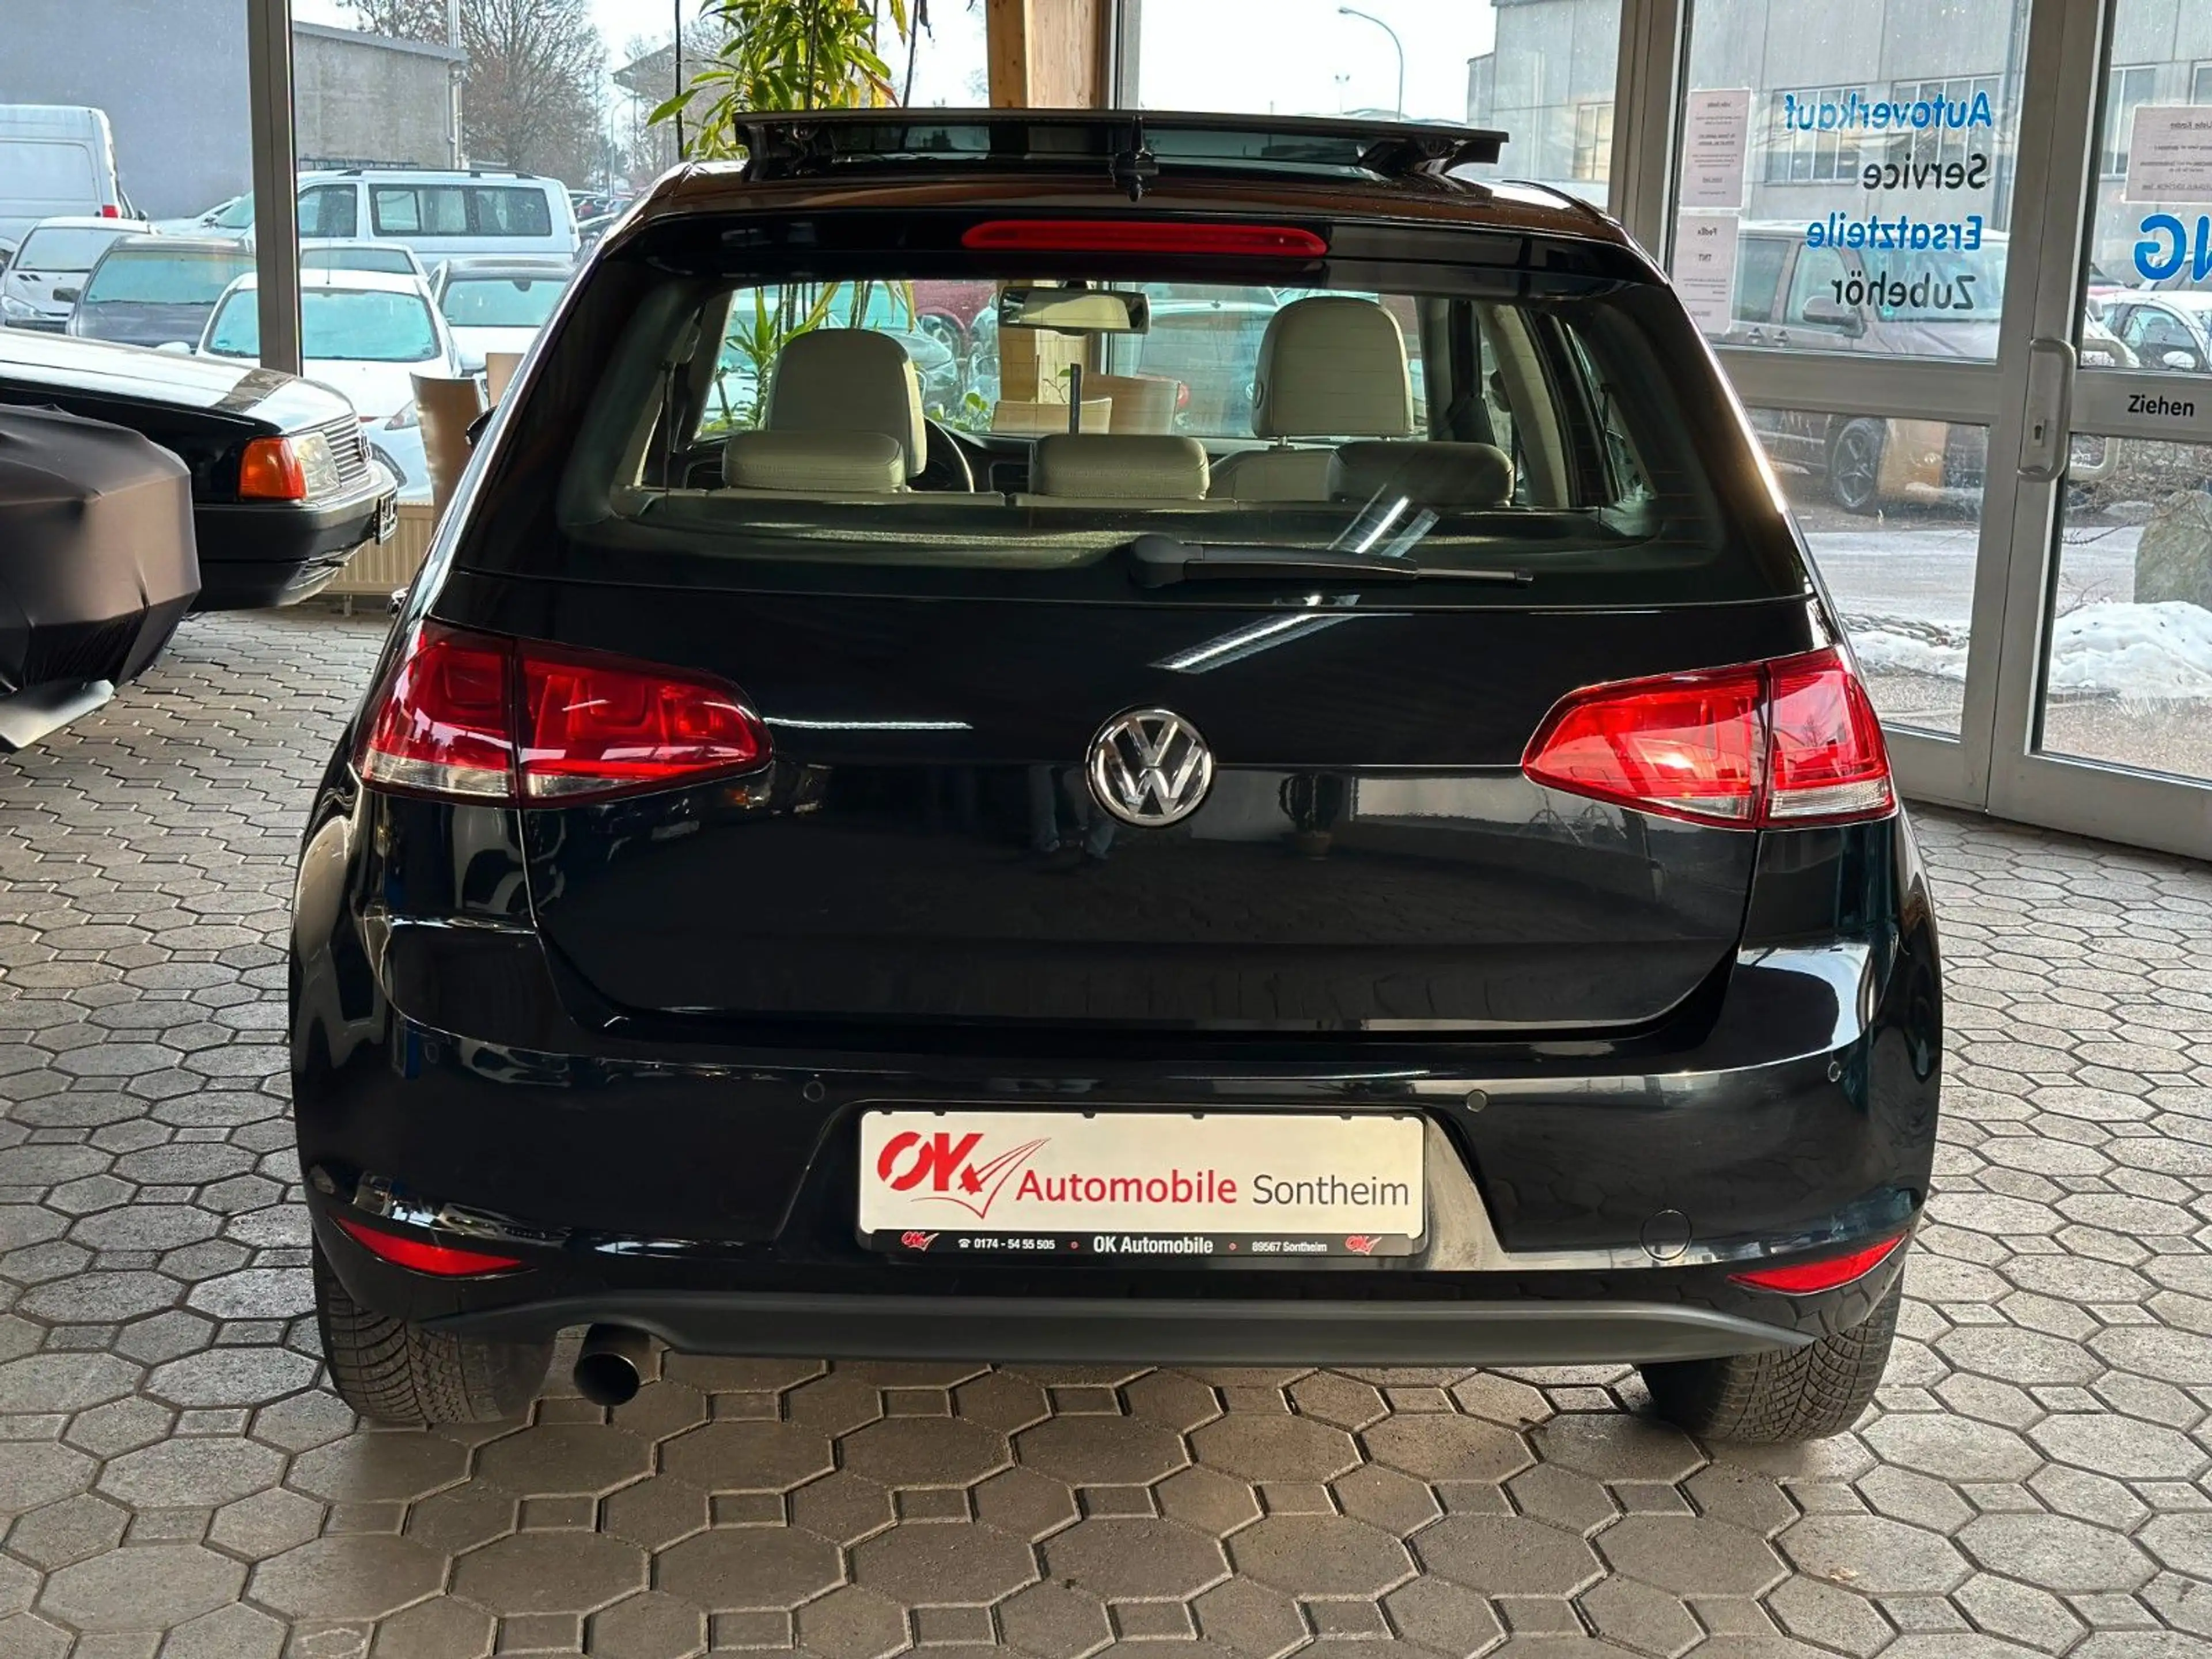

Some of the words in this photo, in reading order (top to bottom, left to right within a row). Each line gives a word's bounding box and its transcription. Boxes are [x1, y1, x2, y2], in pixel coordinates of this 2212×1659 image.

[2127, 393, 2195, 418] Ziehen
[877, 1131, 984, 1196] OK
[1015, 1169, 1237, 1204] Automobile
[1252, 1174, 1408, 1206] Sontheim
[974, 1238, 999, 1249] 0174
[1007, 1238, 1020, 1249] 54
[1021, 1238, 1035, 1250] 55
[1036, 1239, 1056, 1250] 505
[1093, 1235, 1117, 1253] OK
[1120, 1236, 1214, 1254] Automobile
[1252, 1241, 1282, 1252] 89567
[1282, 1242, 1327, 1252] Sontheim
